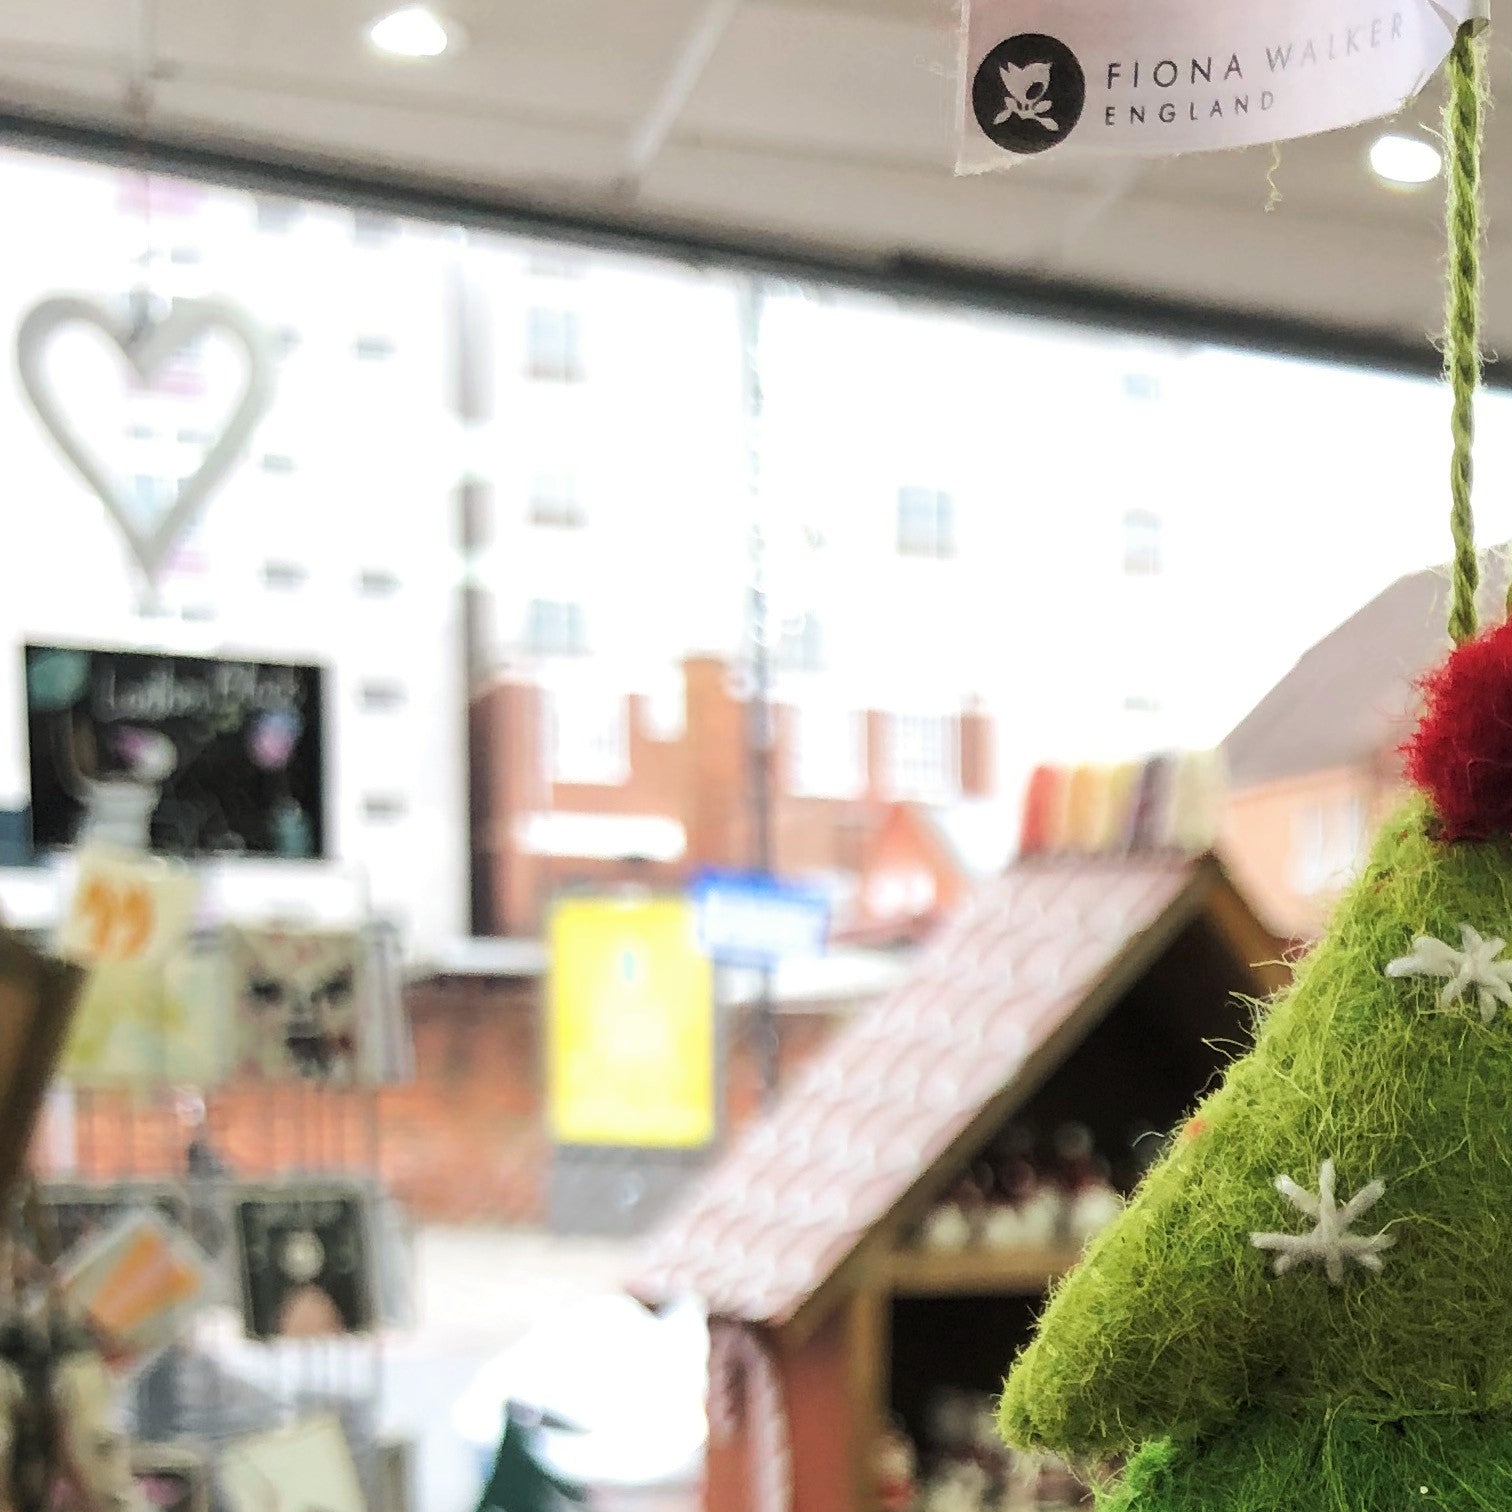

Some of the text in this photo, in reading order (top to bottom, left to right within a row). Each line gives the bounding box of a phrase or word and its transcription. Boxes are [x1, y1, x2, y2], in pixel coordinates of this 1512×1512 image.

[1106, 12, 1404, 90] FIONA WALKER
[1104, 90, 1275, 126] ENGLAND
